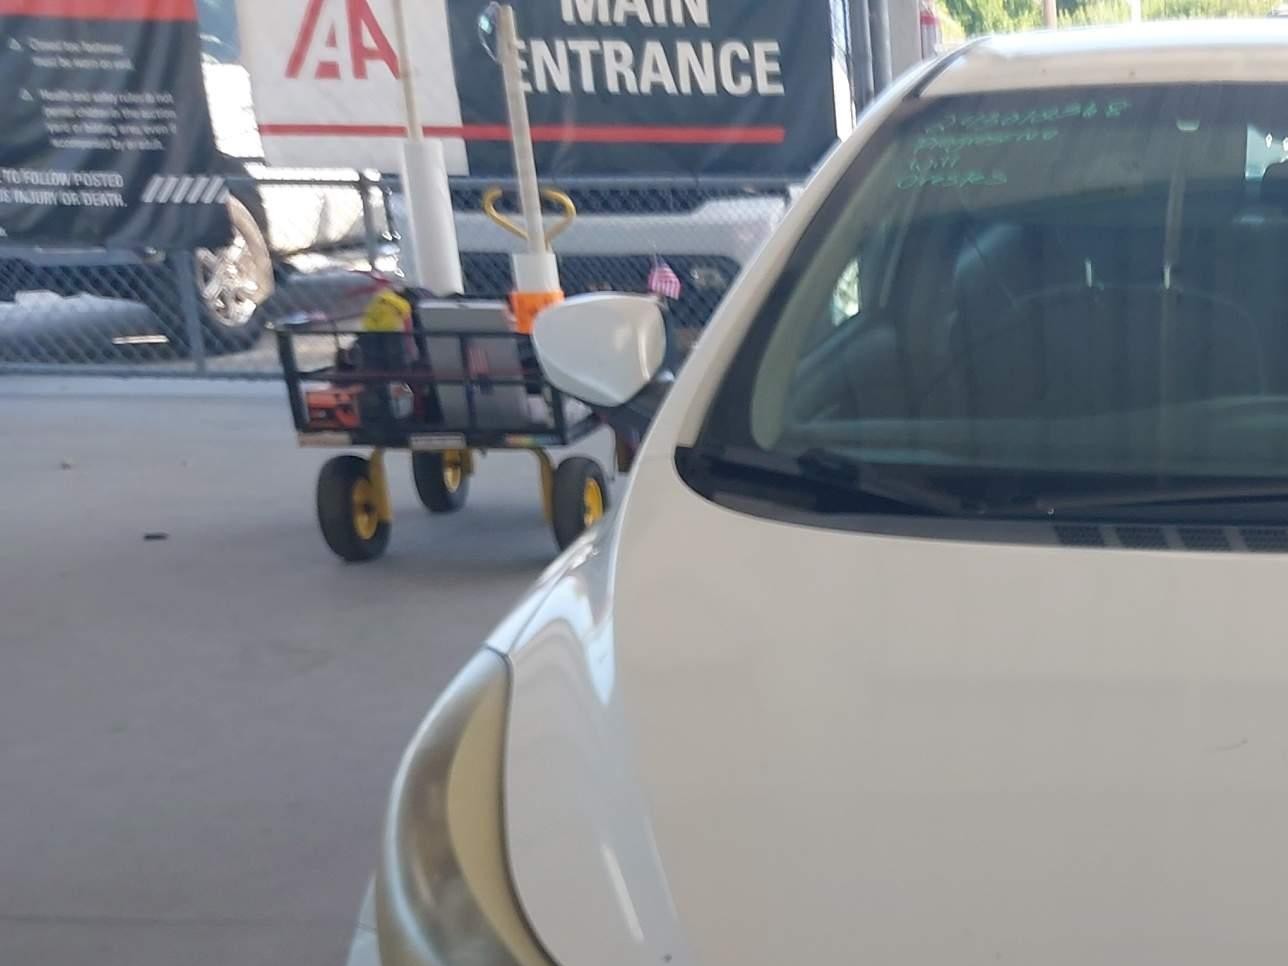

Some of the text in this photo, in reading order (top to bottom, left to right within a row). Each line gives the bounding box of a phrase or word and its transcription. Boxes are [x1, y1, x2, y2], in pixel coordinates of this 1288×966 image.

[561, 0, 710, 26] MAIN
[24, 171, 71, 187] FOLLOW
[74, 171, 124, 187] POSTED
[15, 190, 58, 205] INJURY
[62, 191, 81, 206] OR
